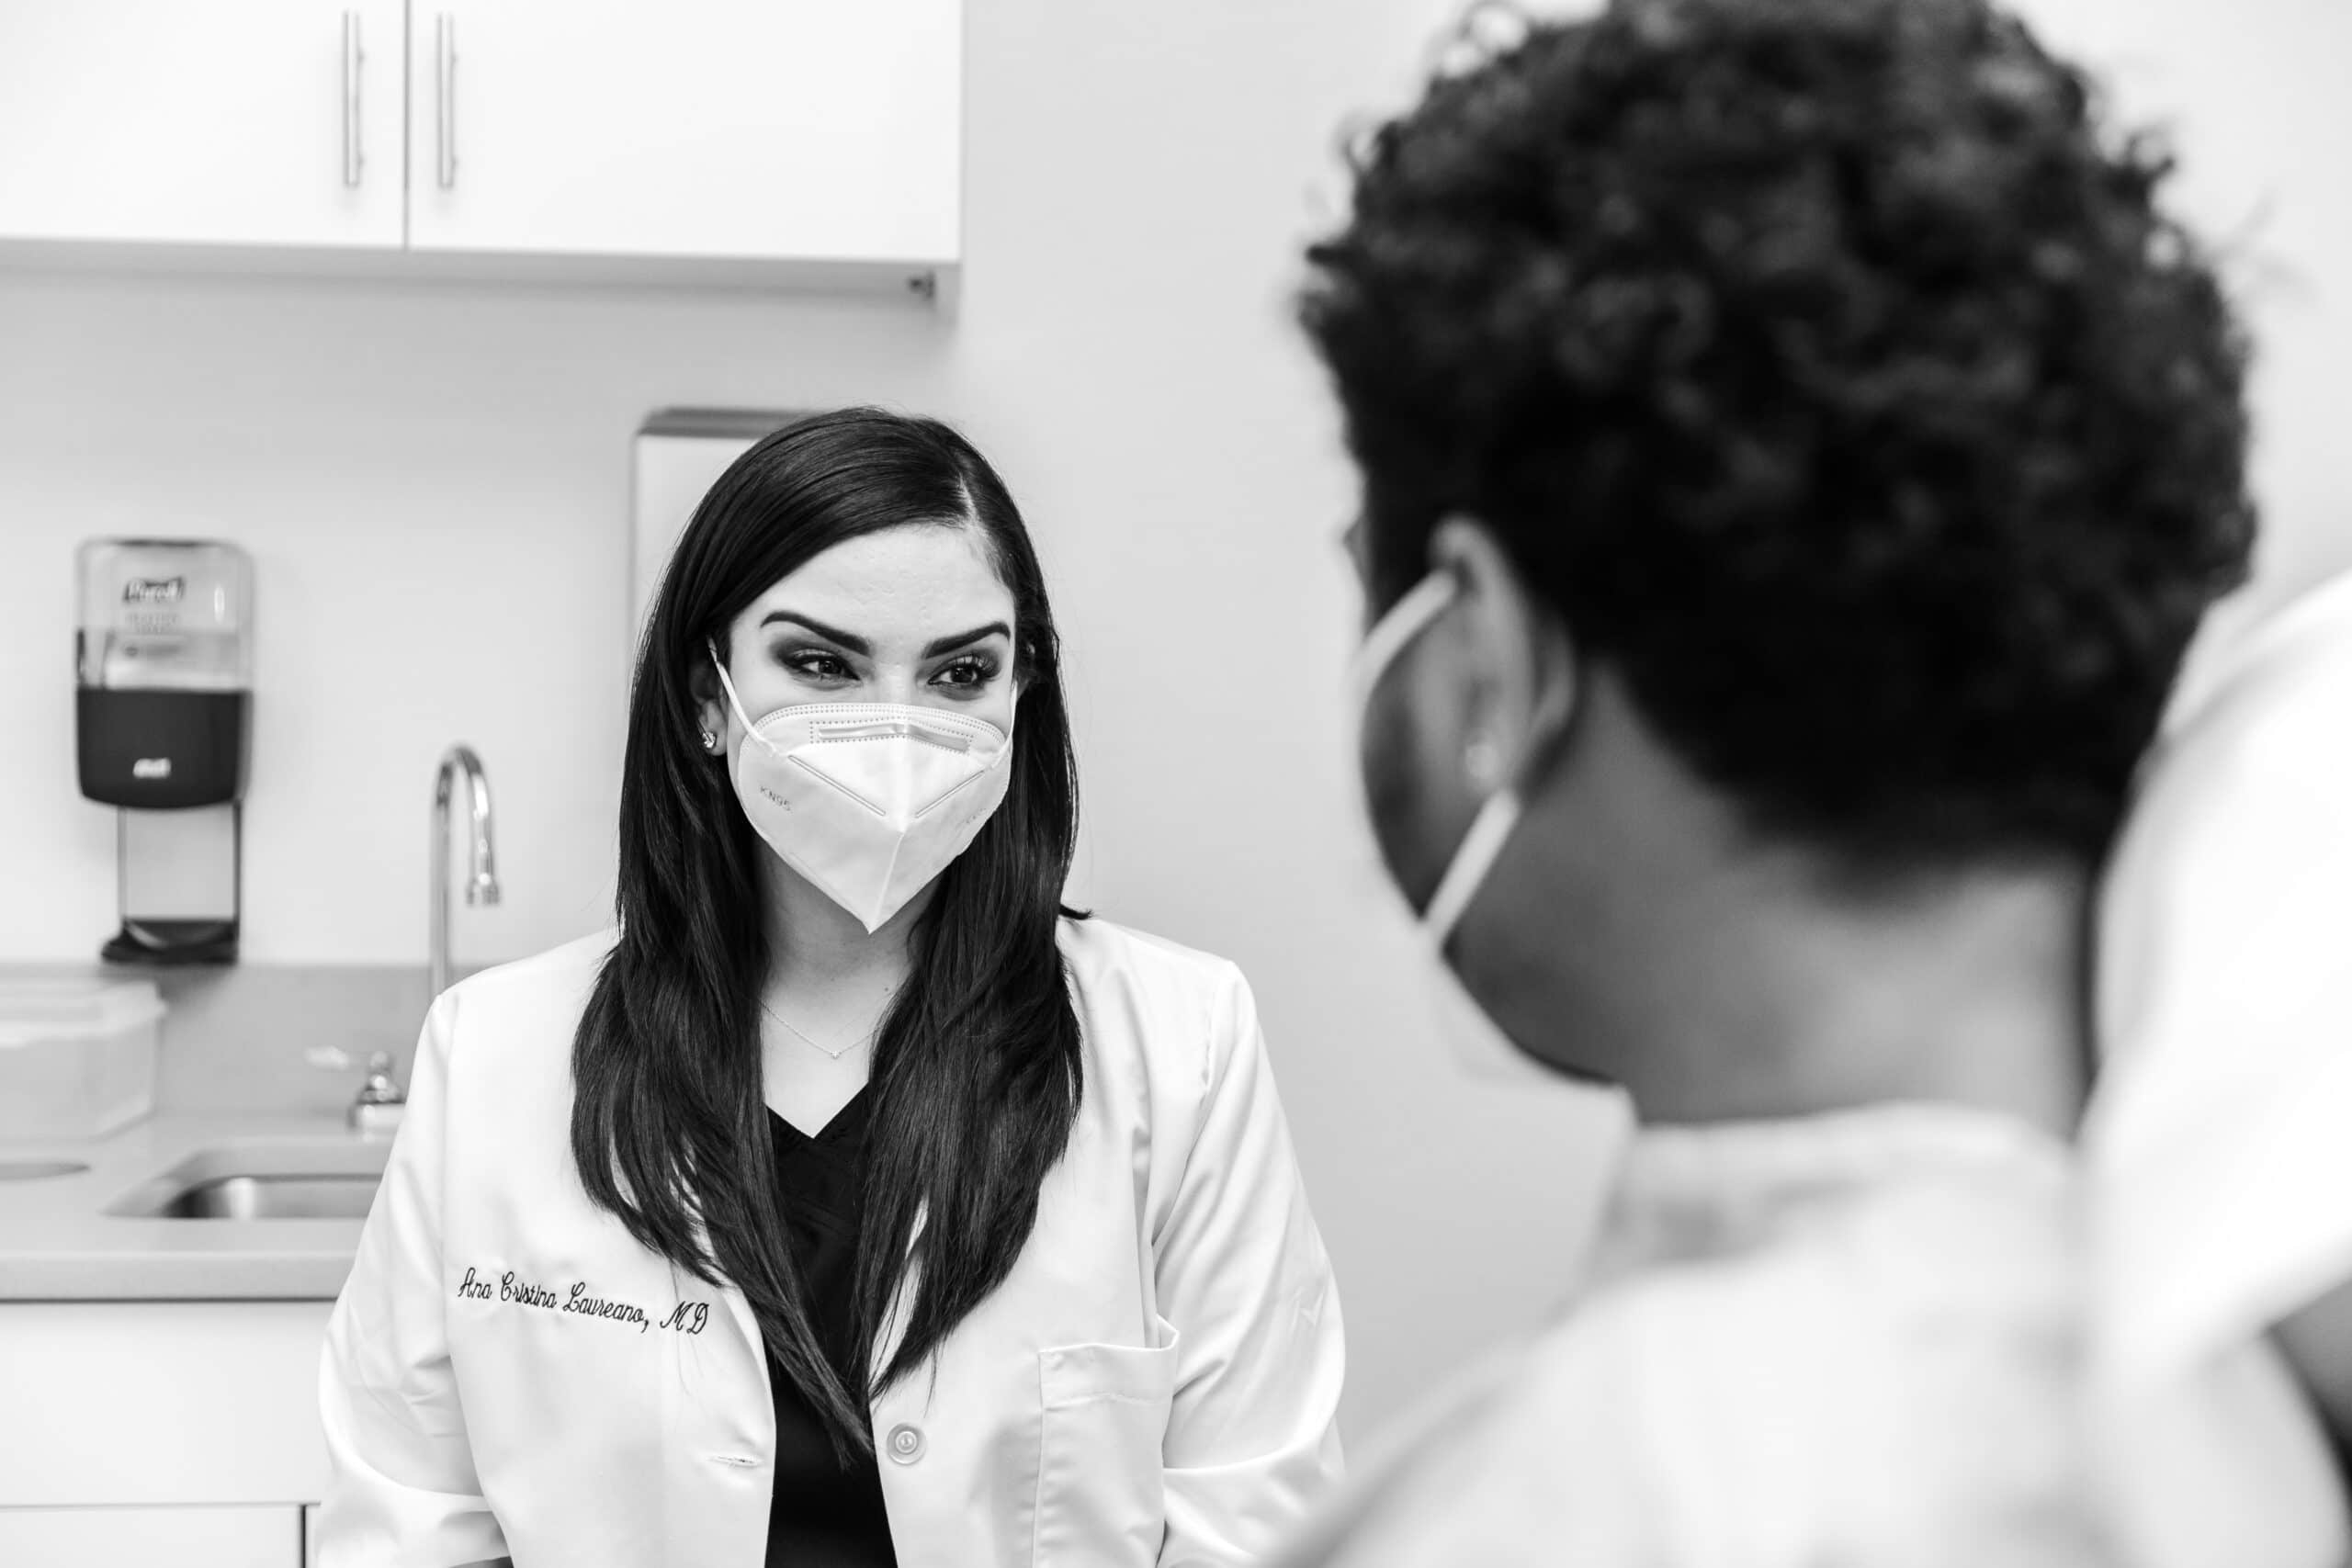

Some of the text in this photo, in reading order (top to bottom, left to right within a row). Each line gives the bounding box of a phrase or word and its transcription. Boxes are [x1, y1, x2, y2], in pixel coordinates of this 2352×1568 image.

[759, 784, 793, 813] KN95
[458, 1267, 710, 1335] Ana Cristina Laureano, MD
